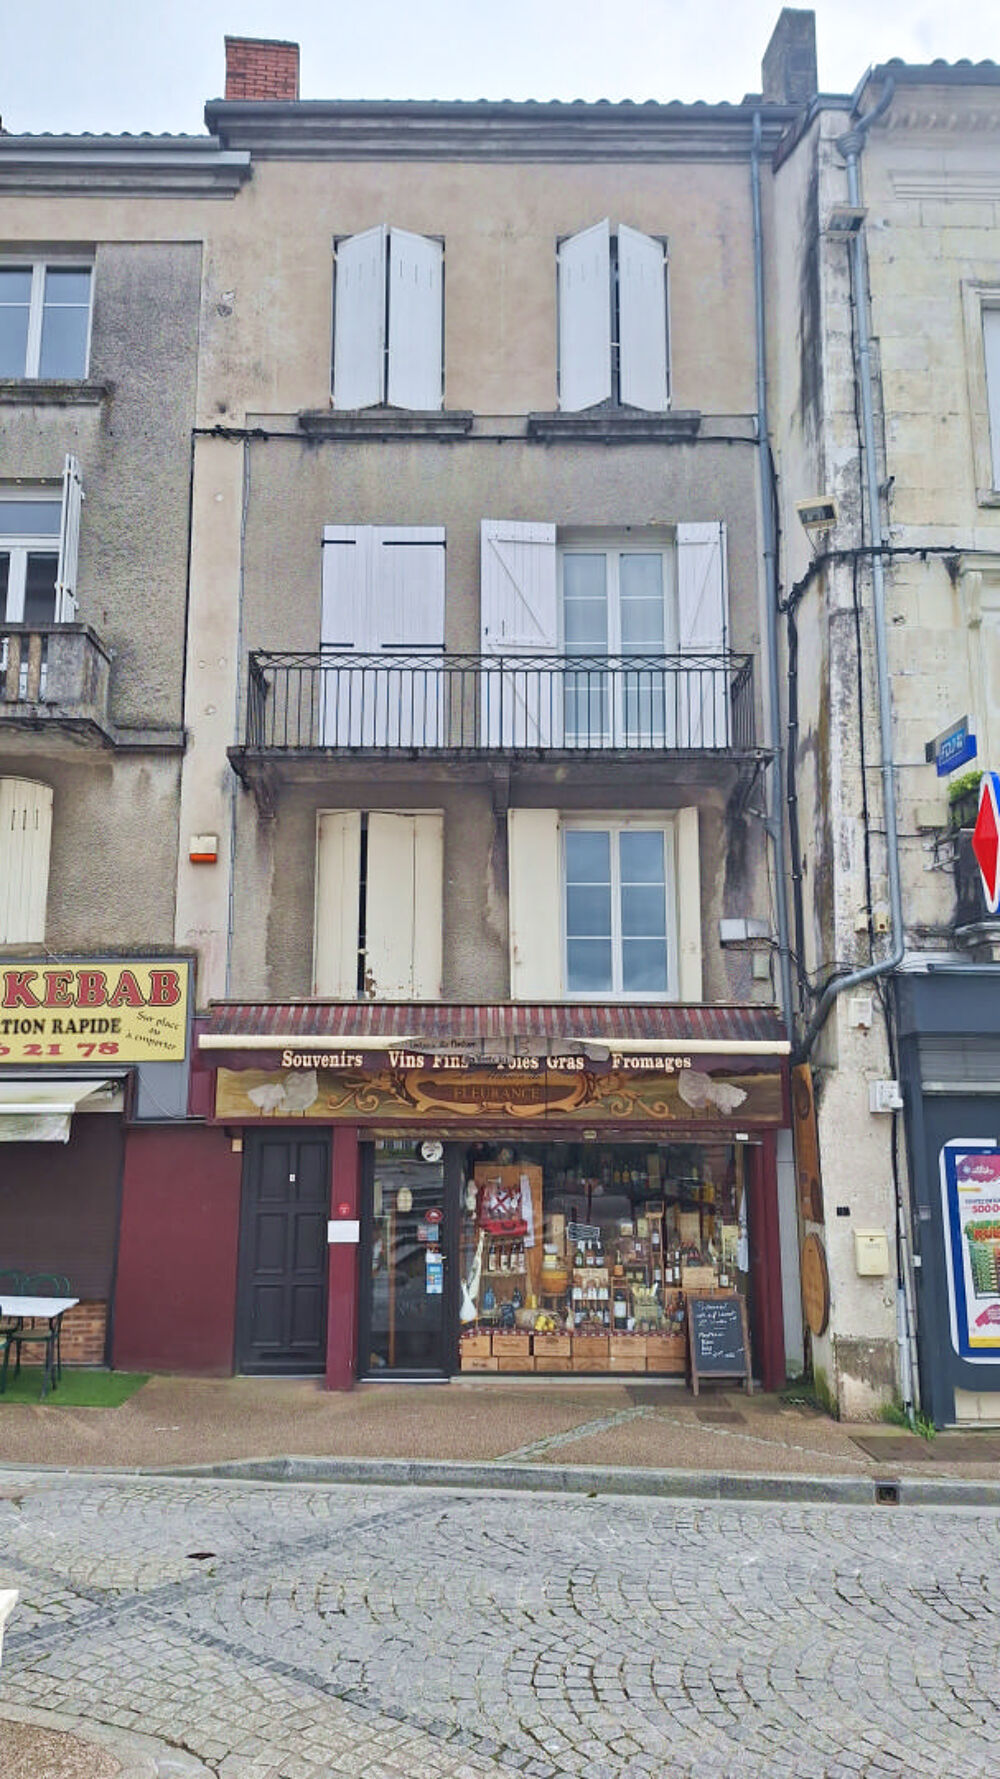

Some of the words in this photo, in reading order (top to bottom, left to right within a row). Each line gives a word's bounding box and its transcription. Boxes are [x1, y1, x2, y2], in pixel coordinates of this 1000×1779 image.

[3, 970, 182, 1009] KEBAB
[0, 1018, 46, 1034] TION
[52, 1018, 121, 1034] RAPIDE
[137, 1011, 154, 1022] Sur
[156, 1017, 181, 1030] place
[22, 1043, 64, 1056] 21
[77, 1042, 120, 1058] 78
[281, 1050, 364, 1068] Souvenirs
[388, 1051, 425, 1068] Vins
[496, 1055, 538, 1070] oies
[546, 1054, 585, 1070] Gras
[611, 1053, 693, 1072] Fromages
[453, 1086, 541, 1101] FLEURANCE
